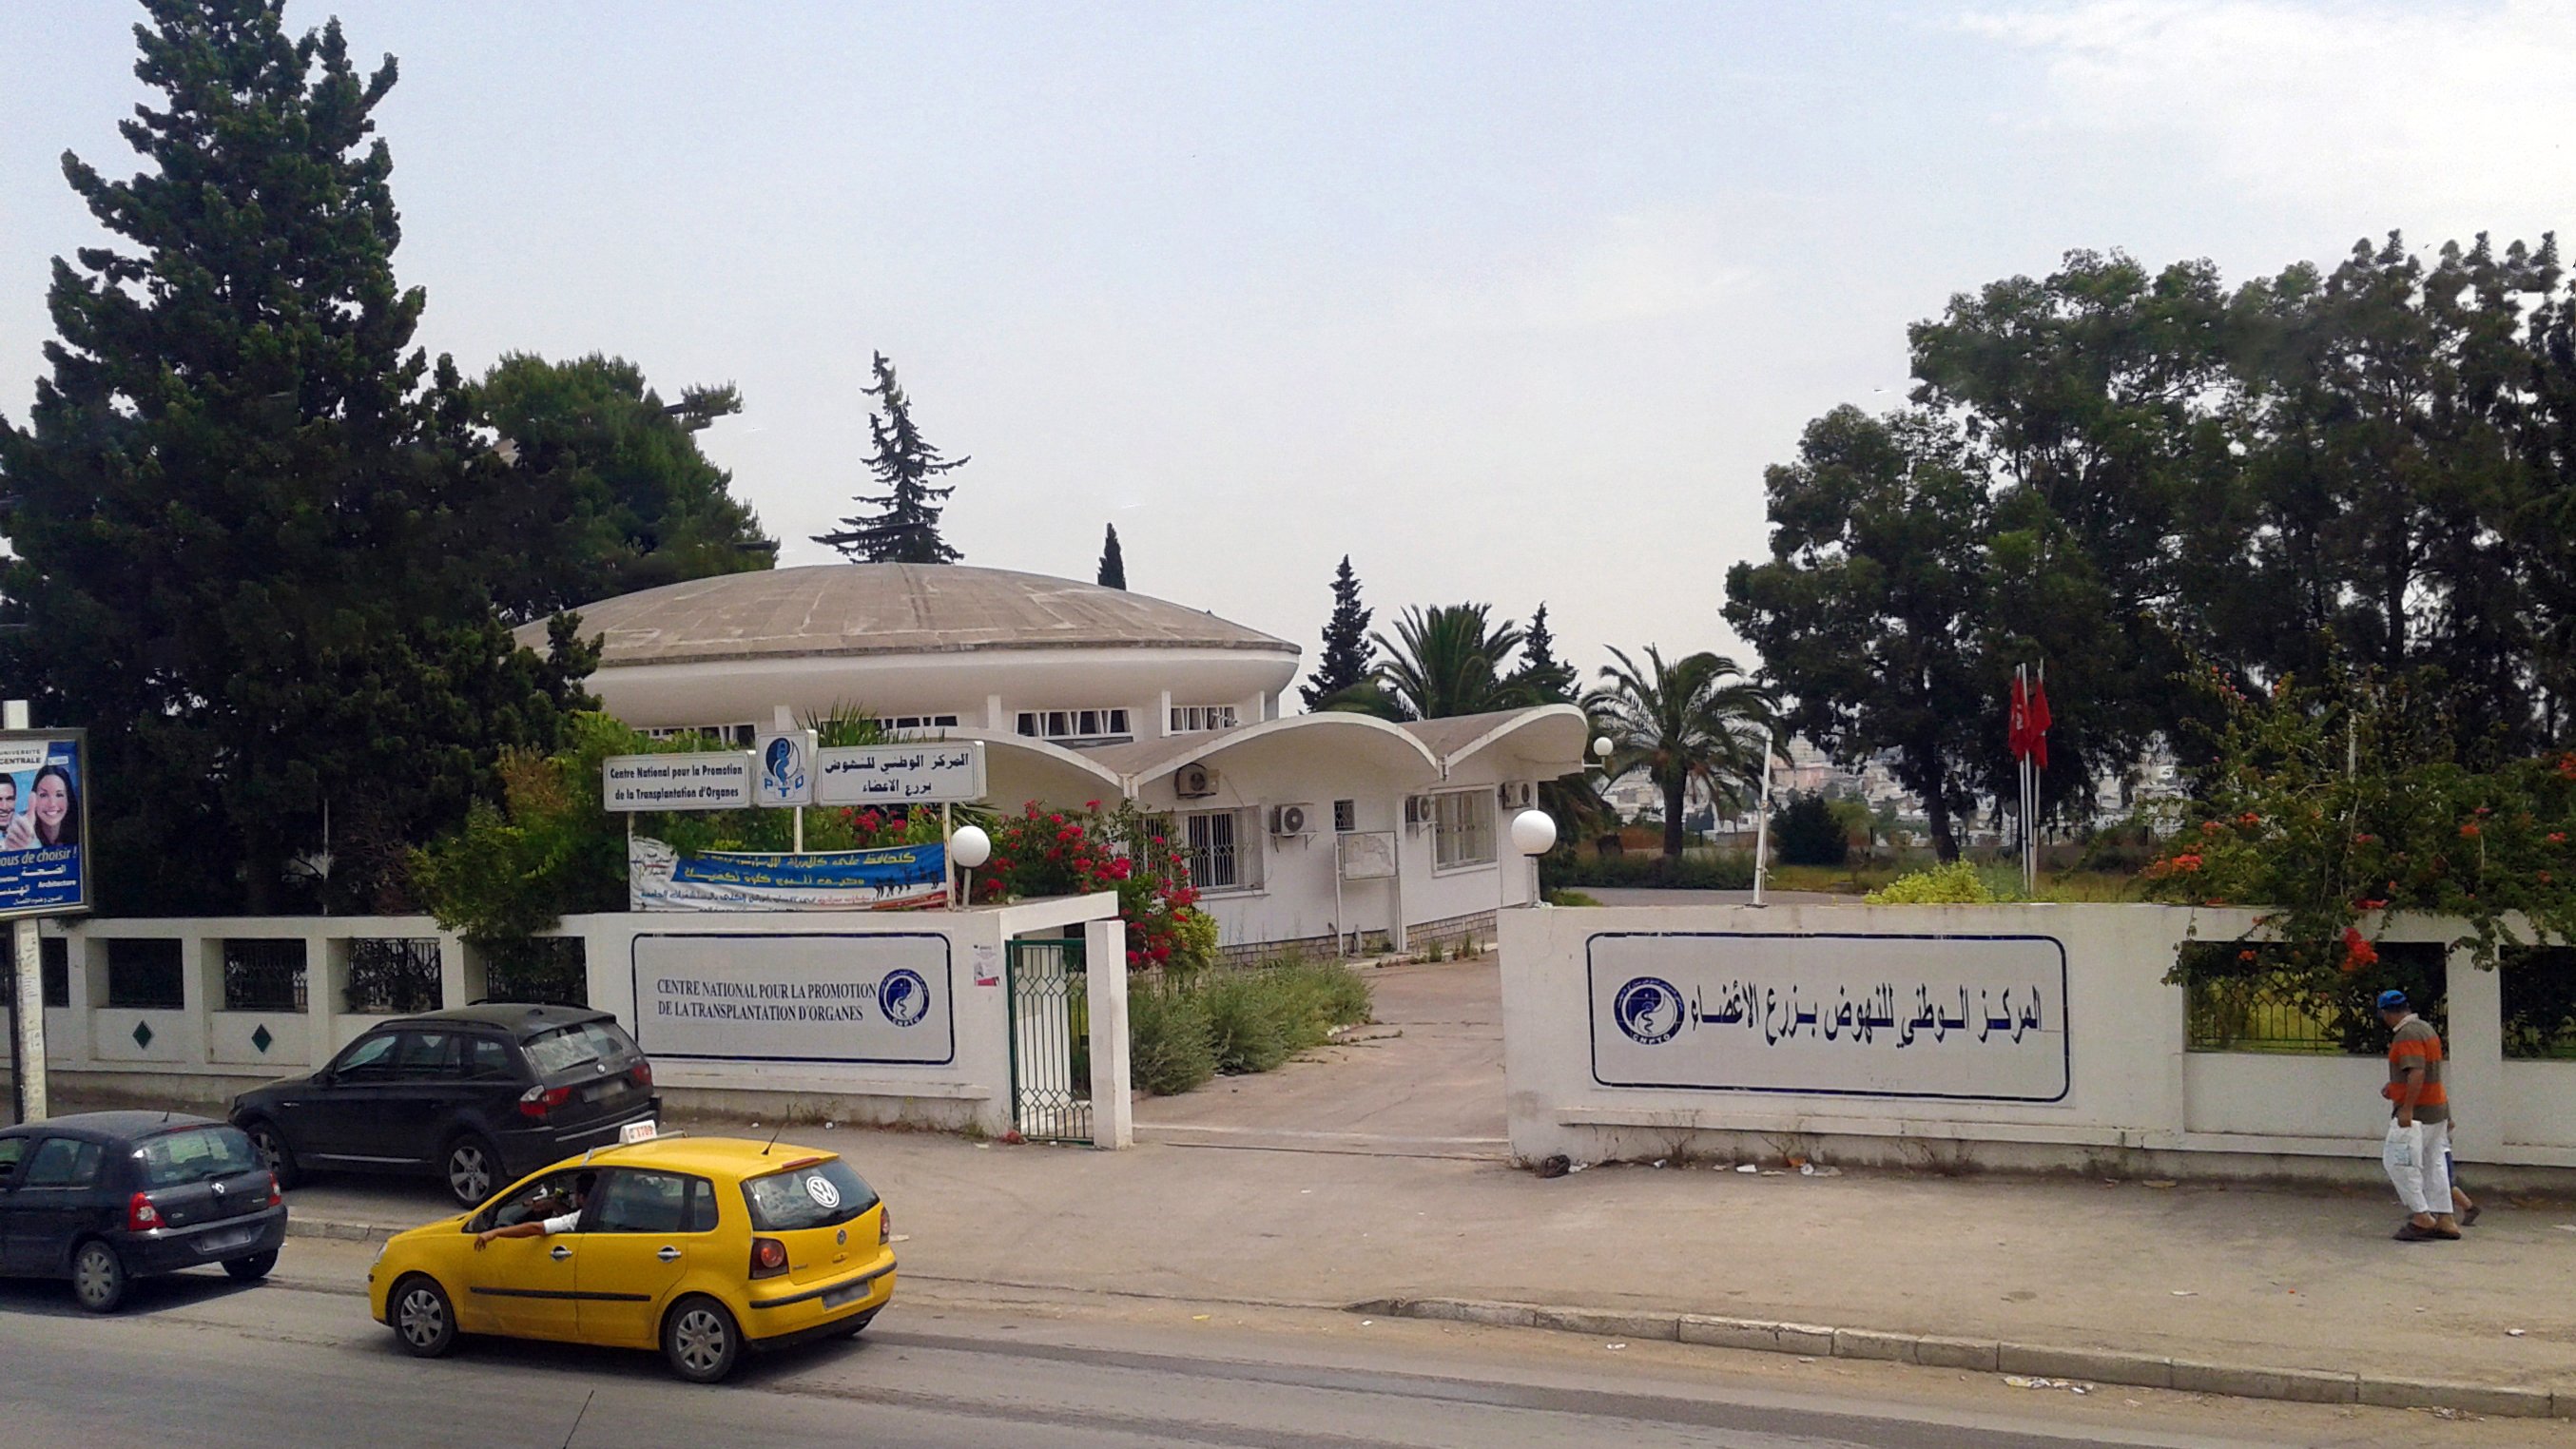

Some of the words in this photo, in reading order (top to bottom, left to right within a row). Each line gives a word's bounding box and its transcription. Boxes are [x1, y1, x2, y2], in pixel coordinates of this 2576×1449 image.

[610, 767, 635, 779] Centre
[637, 765, 670, 778] National
[672, 767, 690, 780] pour
[692, 764, 700, 777] la
[702, 763, 743, 777] Promotion
[881, 755, 924, 775] الوطني
[931, 753, 969, 770] المركز
[615, 789, 625, 801] de
[627, 788, 634, 801] la
[636, 786, 696, 802] Transplantation
[699, 785, 739, 801] d'Organes
[0, 856, 19, 866] ous
[21, 851, 35, 864] de
[36, 848, 71, 862] choisir
[657, 978, 701, 996] CENTRE
[703, 981, 758, 999] NATIONAL
[759, 983, 789, 999] POUR
[791, 984, 806, 999] LA
[807, 983, 877, 999] PROMOTION
[658, 1000, 673, 1015] DE
[675, 1001, 689, 1016] LA
[689, 1002, 797, 1021] TRANSPLANTATION
[799, 1005, 863, 1021] D'ORGANES
[1765, 984, 1818, 1047] بزرع
[1824, 982, 1895, 1045] للنهوض
[1895, 982, 1970, 1049] الوطني
[1977, 984, 2043, 1045] المركز
